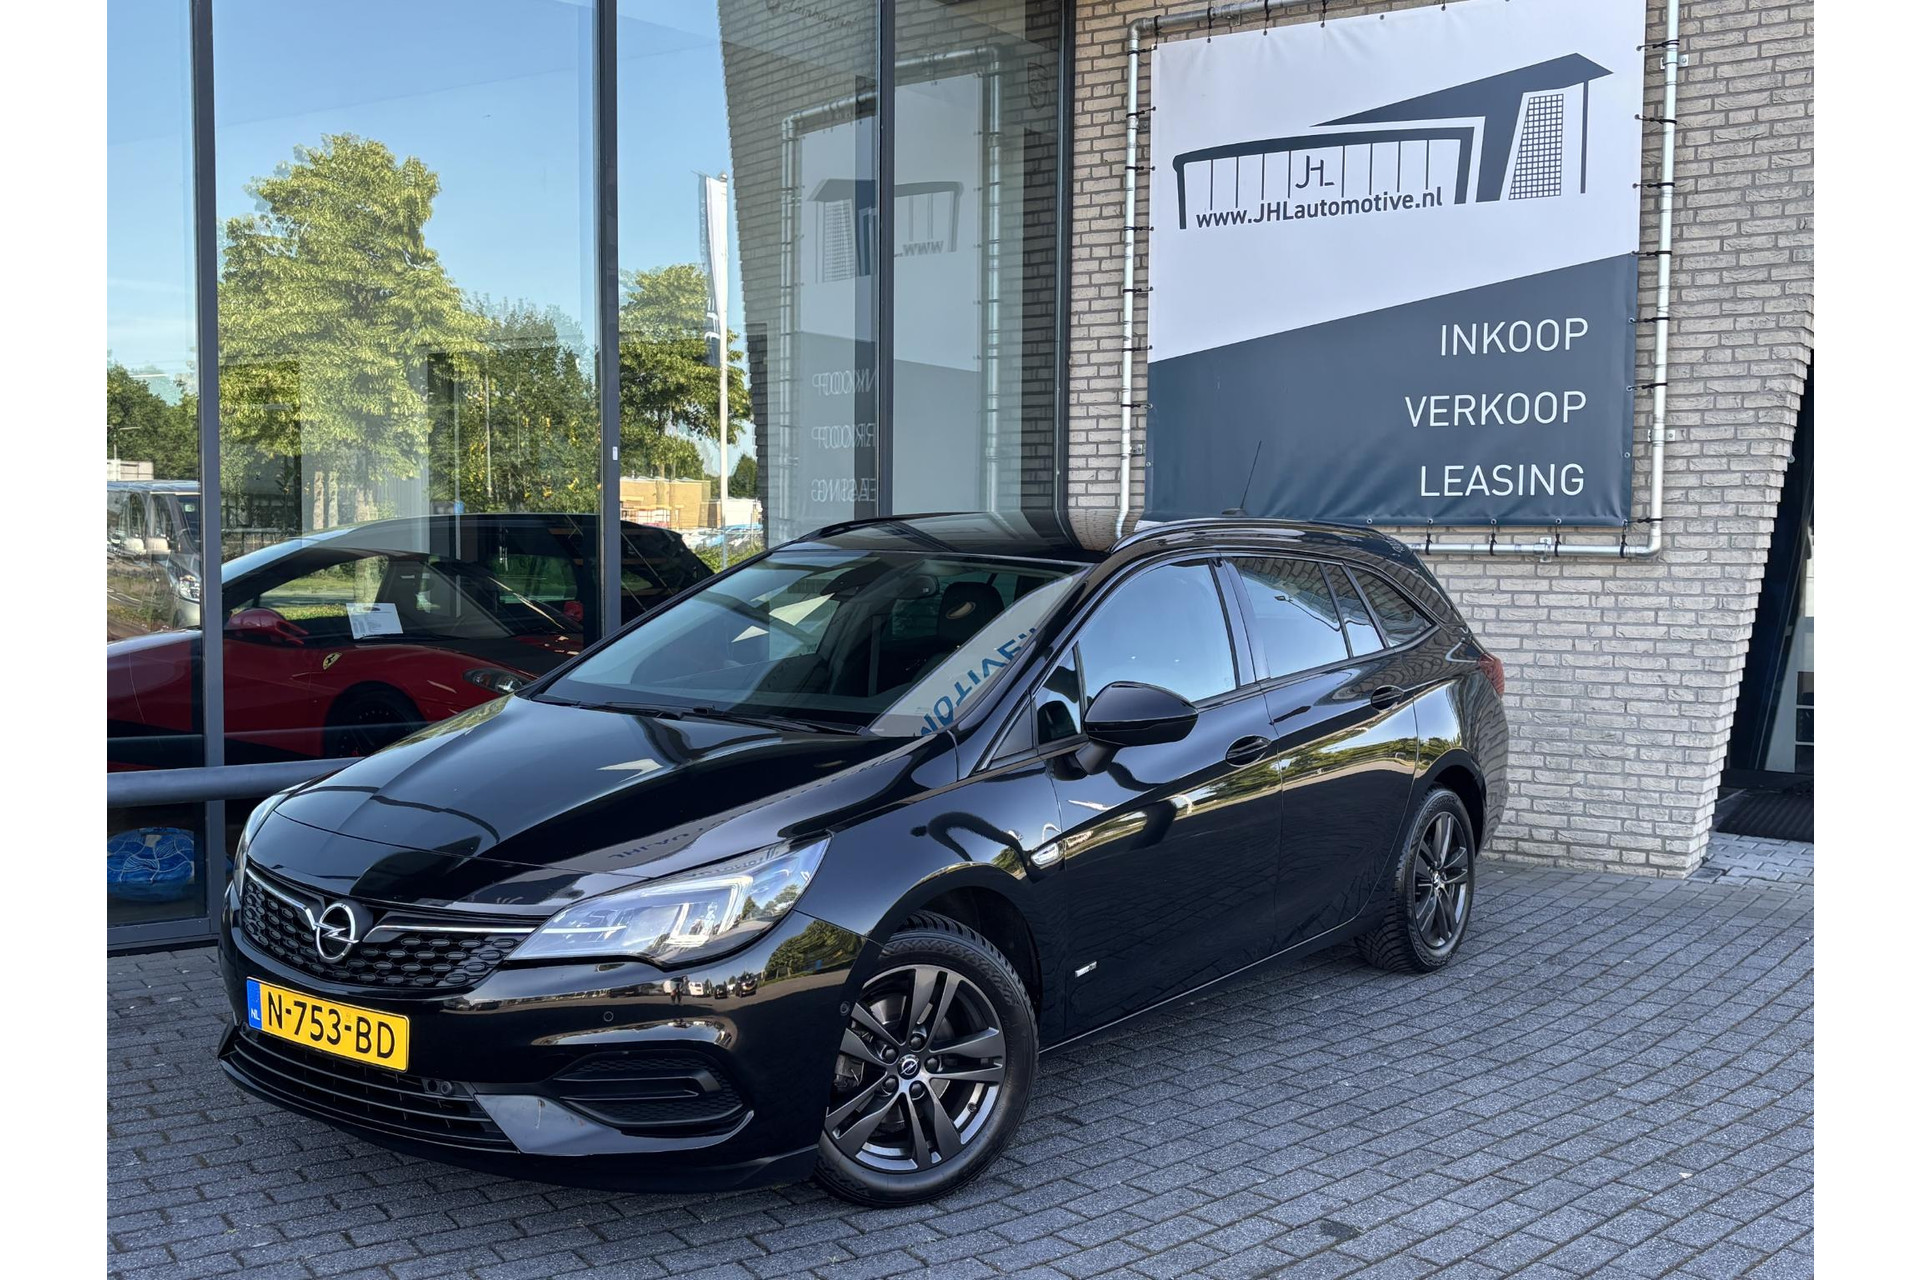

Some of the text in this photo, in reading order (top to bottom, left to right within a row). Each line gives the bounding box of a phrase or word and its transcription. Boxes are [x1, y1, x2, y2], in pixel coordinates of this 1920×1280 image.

[1295, 155, 1335, 189] JHL
[1196, 186, 1443, 229] www.JHLautomotive.nl
[1441, 317, 1589, 356] INKOOP
[1404, 390, 1587, 428] VERKOOP
[1420, 463, 1585, 497] LEASING
[250, 991, 396, 1060] NL N-753-BD
